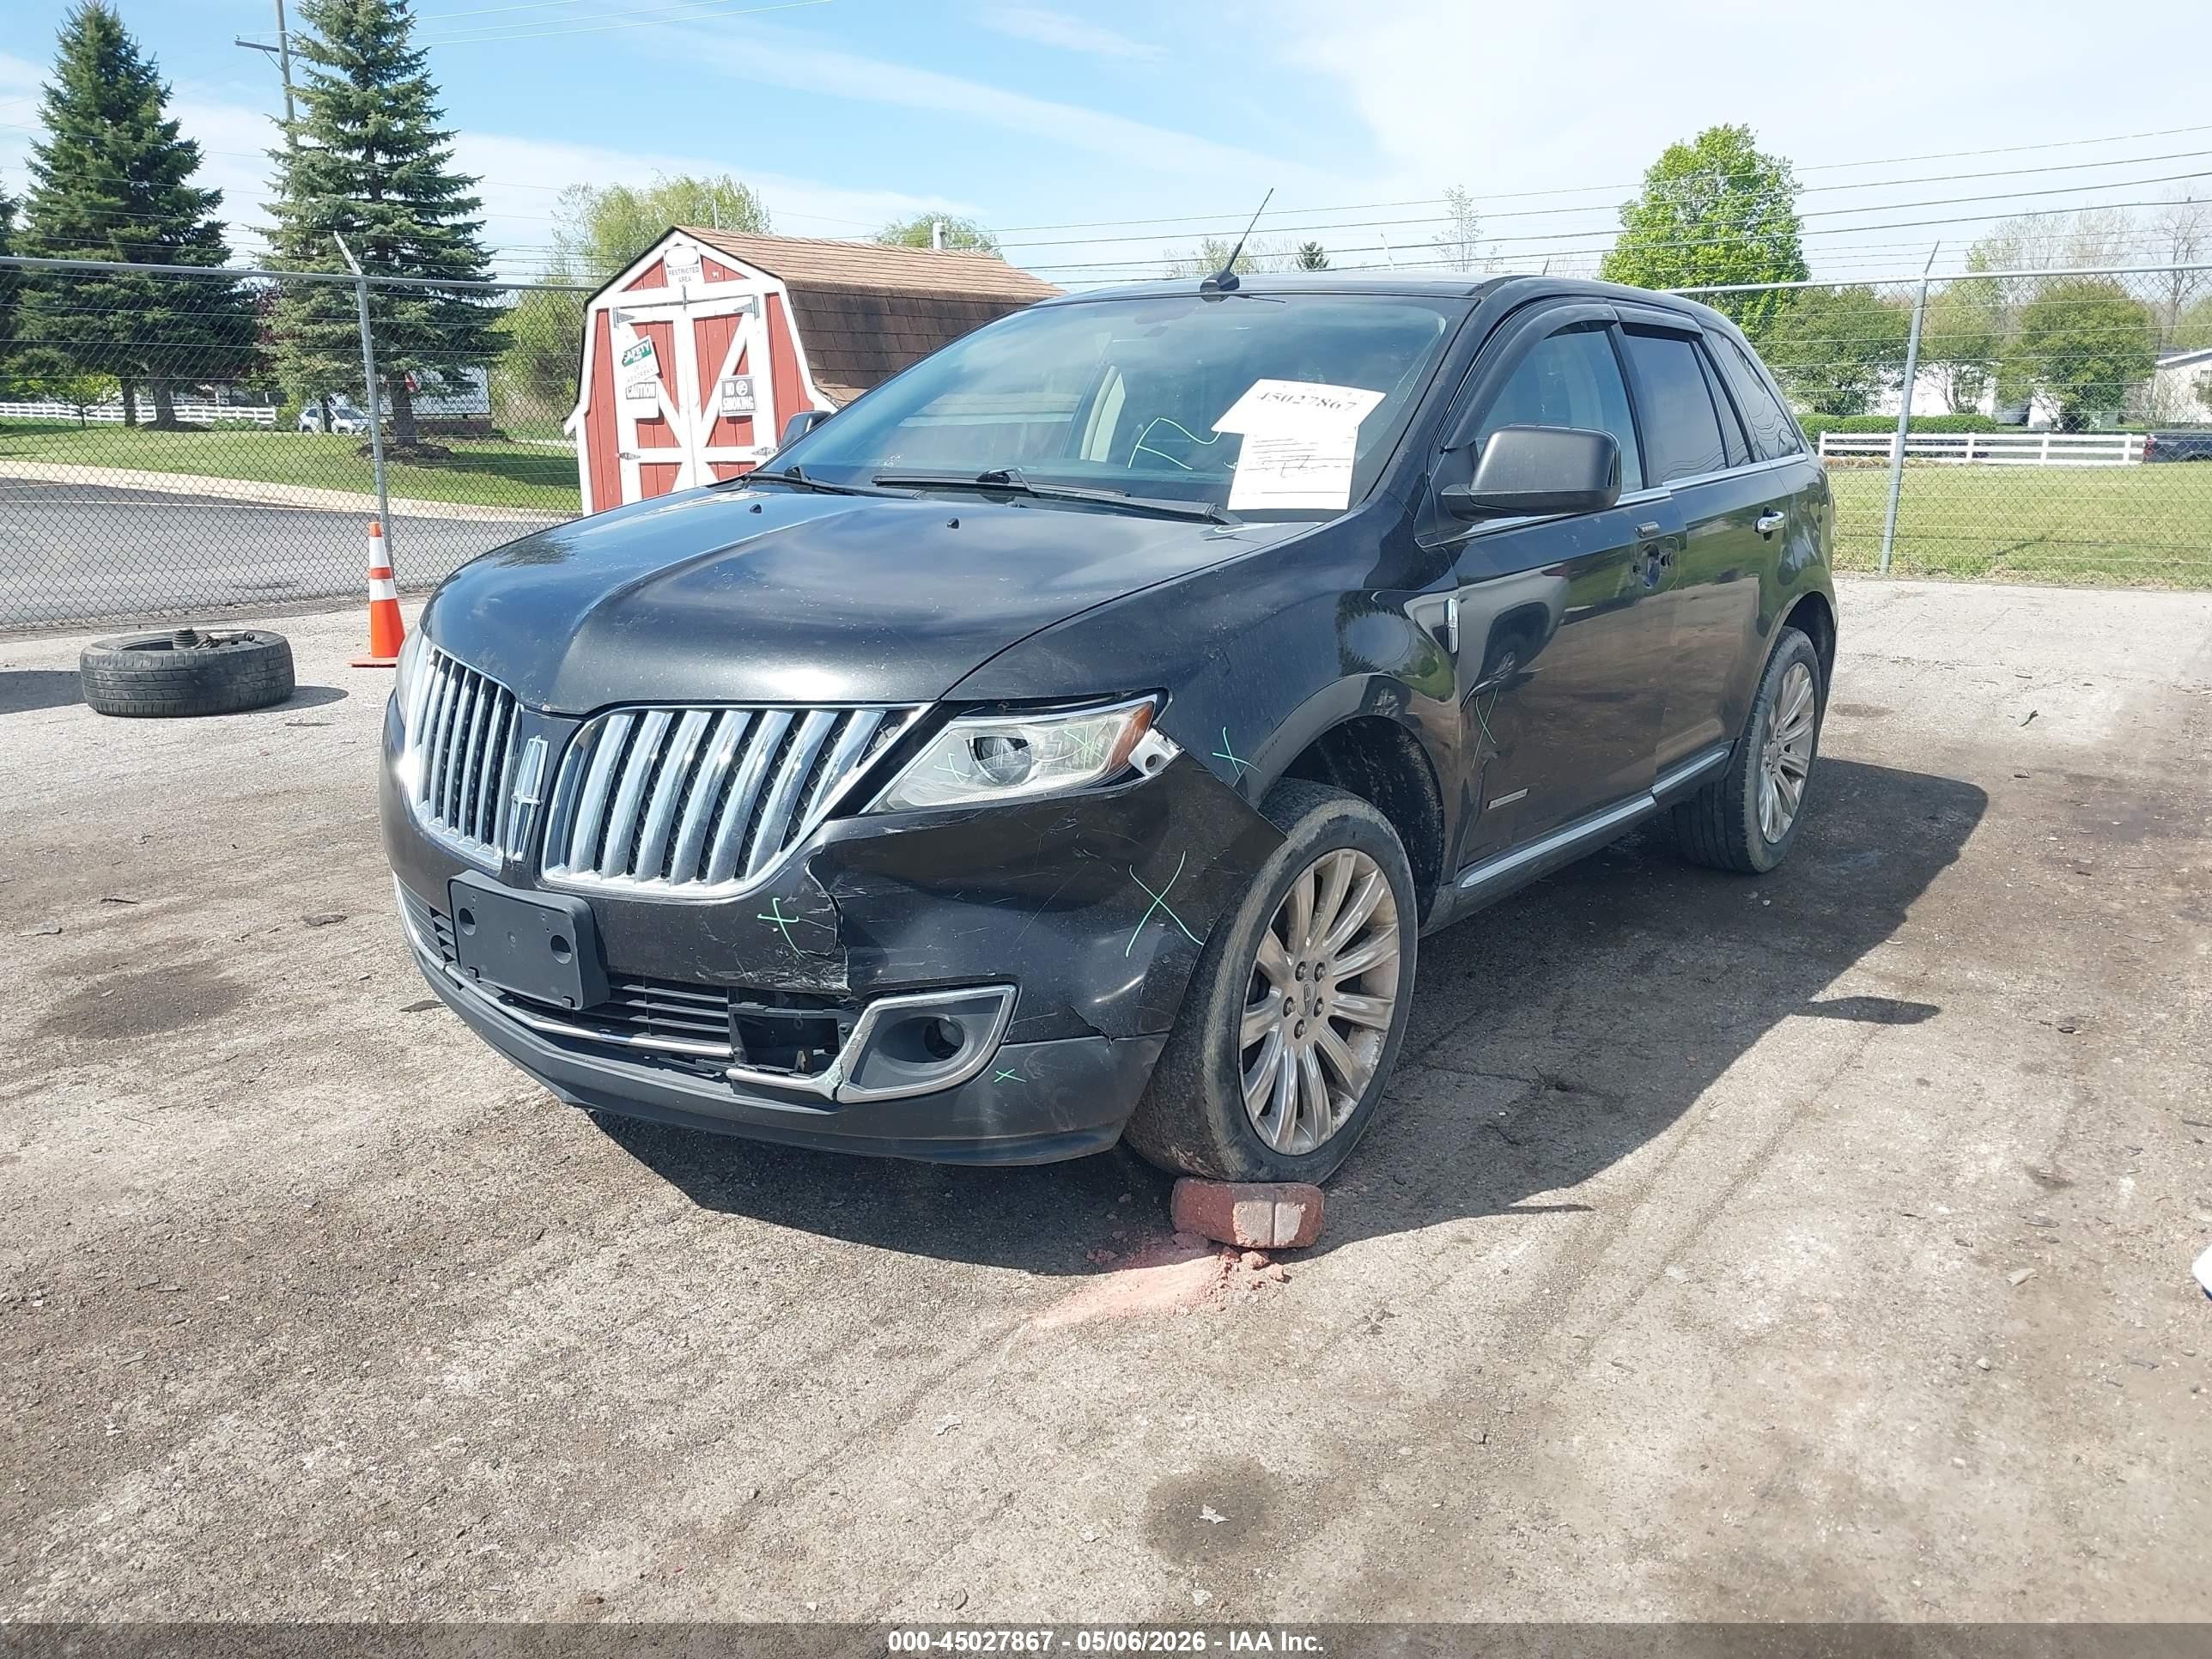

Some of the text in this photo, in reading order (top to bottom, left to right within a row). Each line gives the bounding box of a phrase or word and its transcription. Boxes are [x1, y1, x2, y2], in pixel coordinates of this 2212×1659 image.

[668, 266, 700, 276] RESTRICTED
[626, 383, 656, 399] CAUTION
[725, 382, 735, 397] NO
[723, 396, 755, 410] SMOKING
[1257, 392, 1358, 411] 45027867
